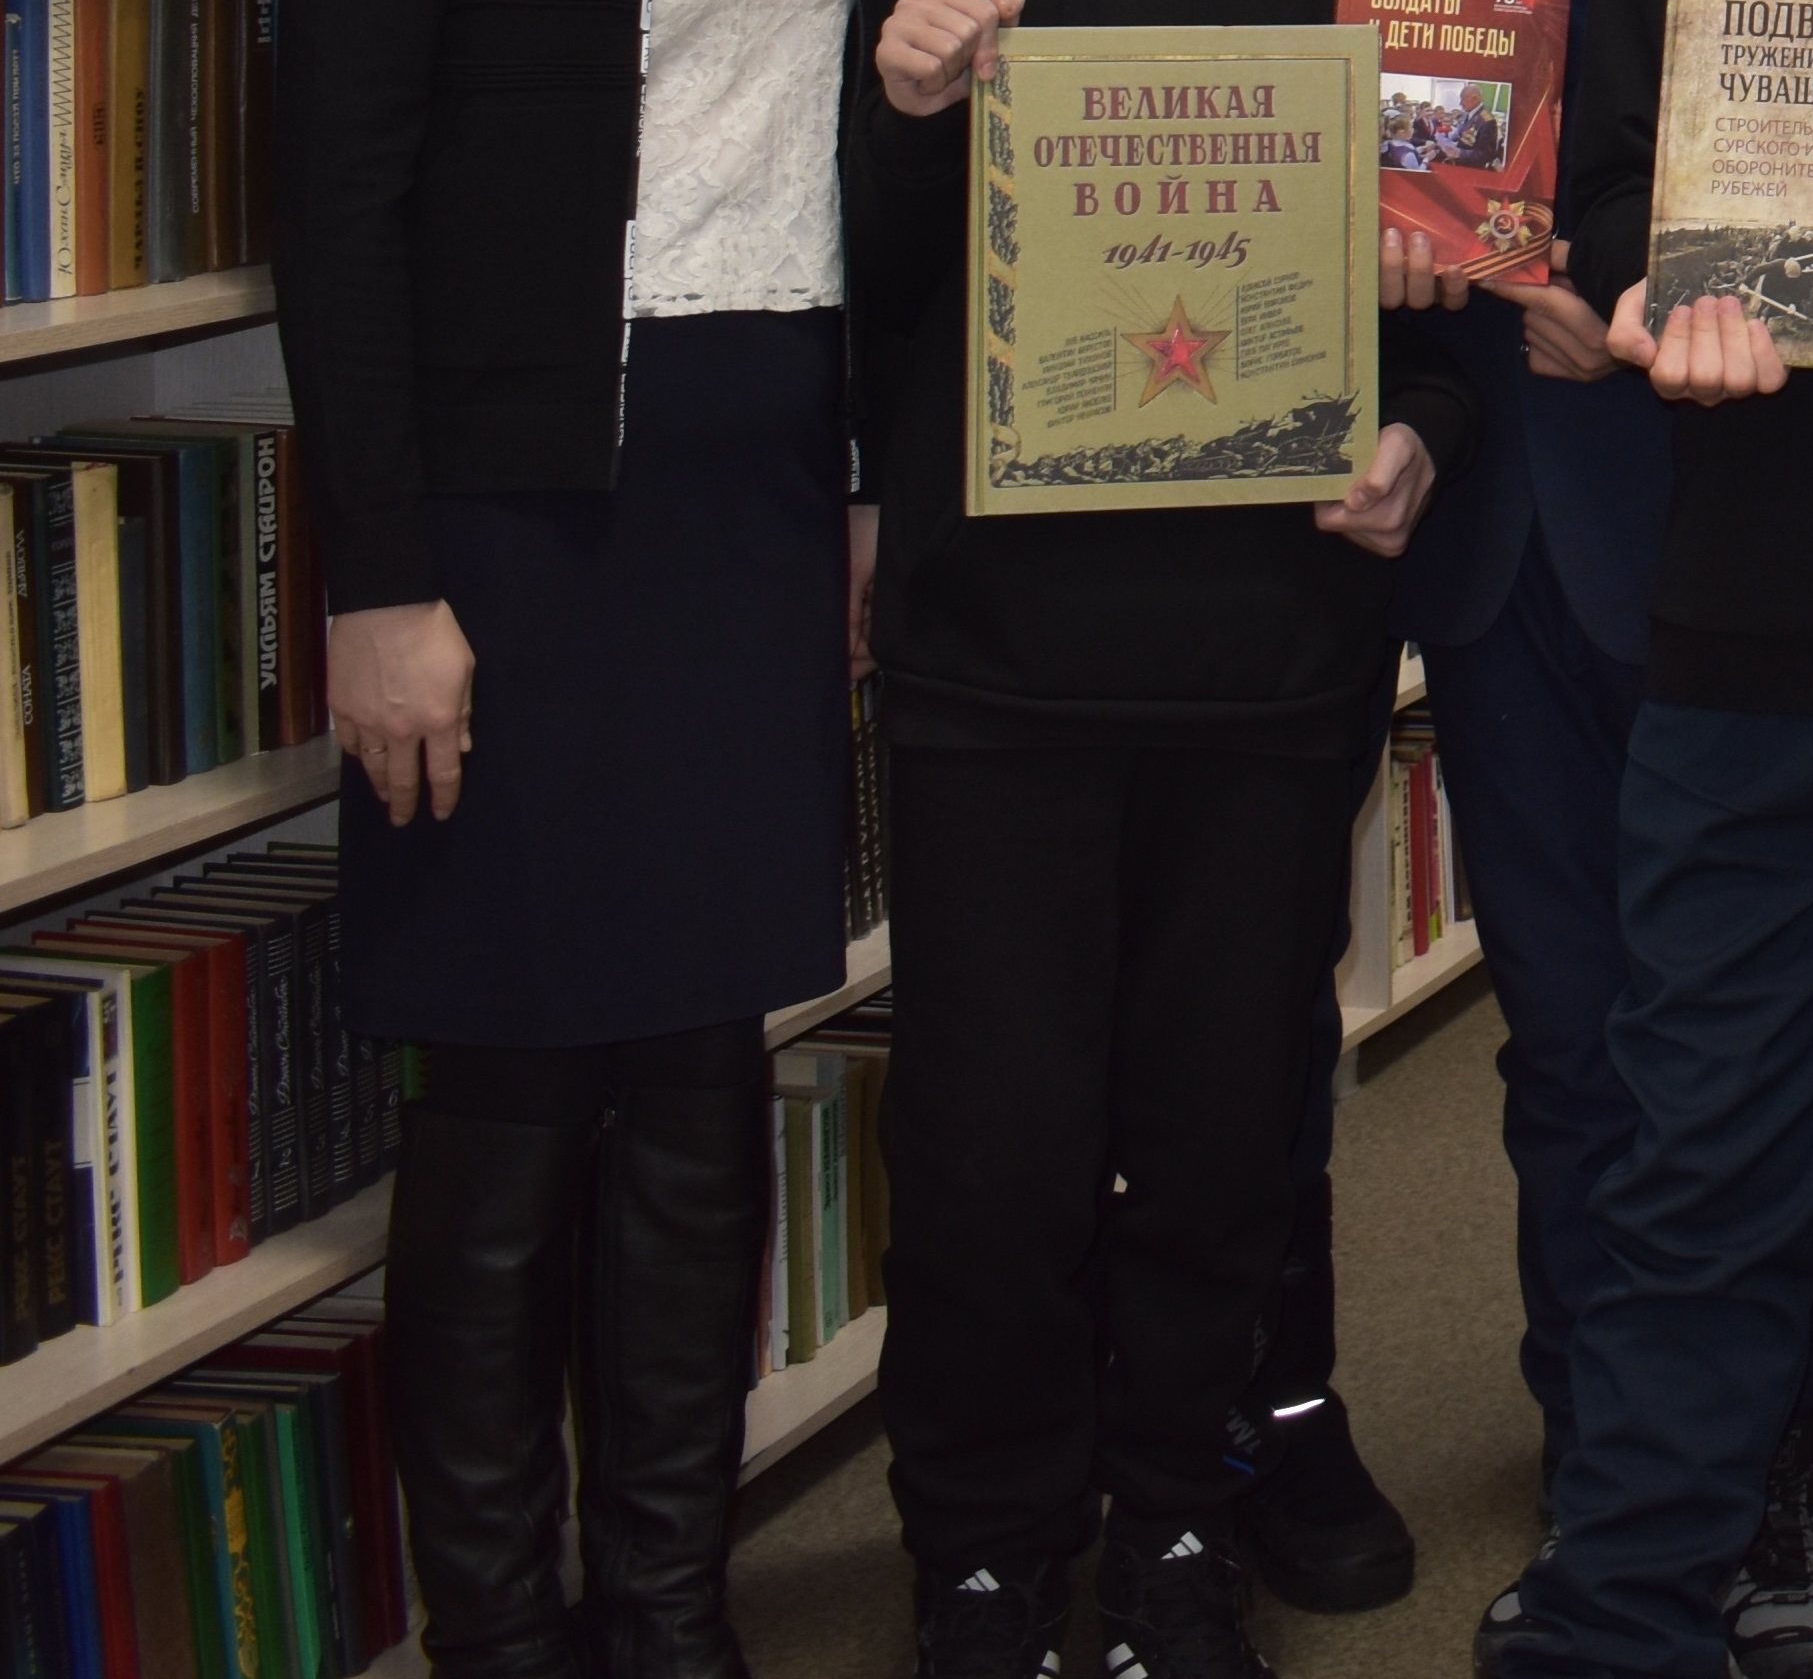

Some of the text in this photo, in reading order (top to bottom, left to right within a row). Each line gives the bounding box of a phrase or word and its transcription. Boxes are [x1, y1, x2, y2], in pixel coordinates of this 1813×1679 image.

[189, 23, 200, 121] ЧЕХОСЛОВАЦКИЙ
[1385, 23, 1515, 57] ДЕТИ ПОБЕДЫ
[1082, 85, 1275, 121] ВЕЛИКАЯ
[190, 126, 200, 214] СОВРЕМЕННЫЙ
[1034, 131, 1321, 168] ОТЕЧЕСТВЕННАЯ
[1713, 139, 1800, 157] СУРСКОГО
[1074, 174, 1282, 216] ВОЙНА
[1711, 179, 1787, 198] РУБЕЖЕЙ
[1102, 231, 1251, 270] 1941-1945
[257, 437, 278, 690] УИЛЬЯМ СТАЙРОН
[15, 528, 34, 725] СОНАТА ДЬЯВОЛА
[275, 975, 292, 1105] Джон Стейнбек
[12, 1156, 29, 1242] СТАУТ
[44, 1138, 66, 1305] РЕКС СТАУТ
